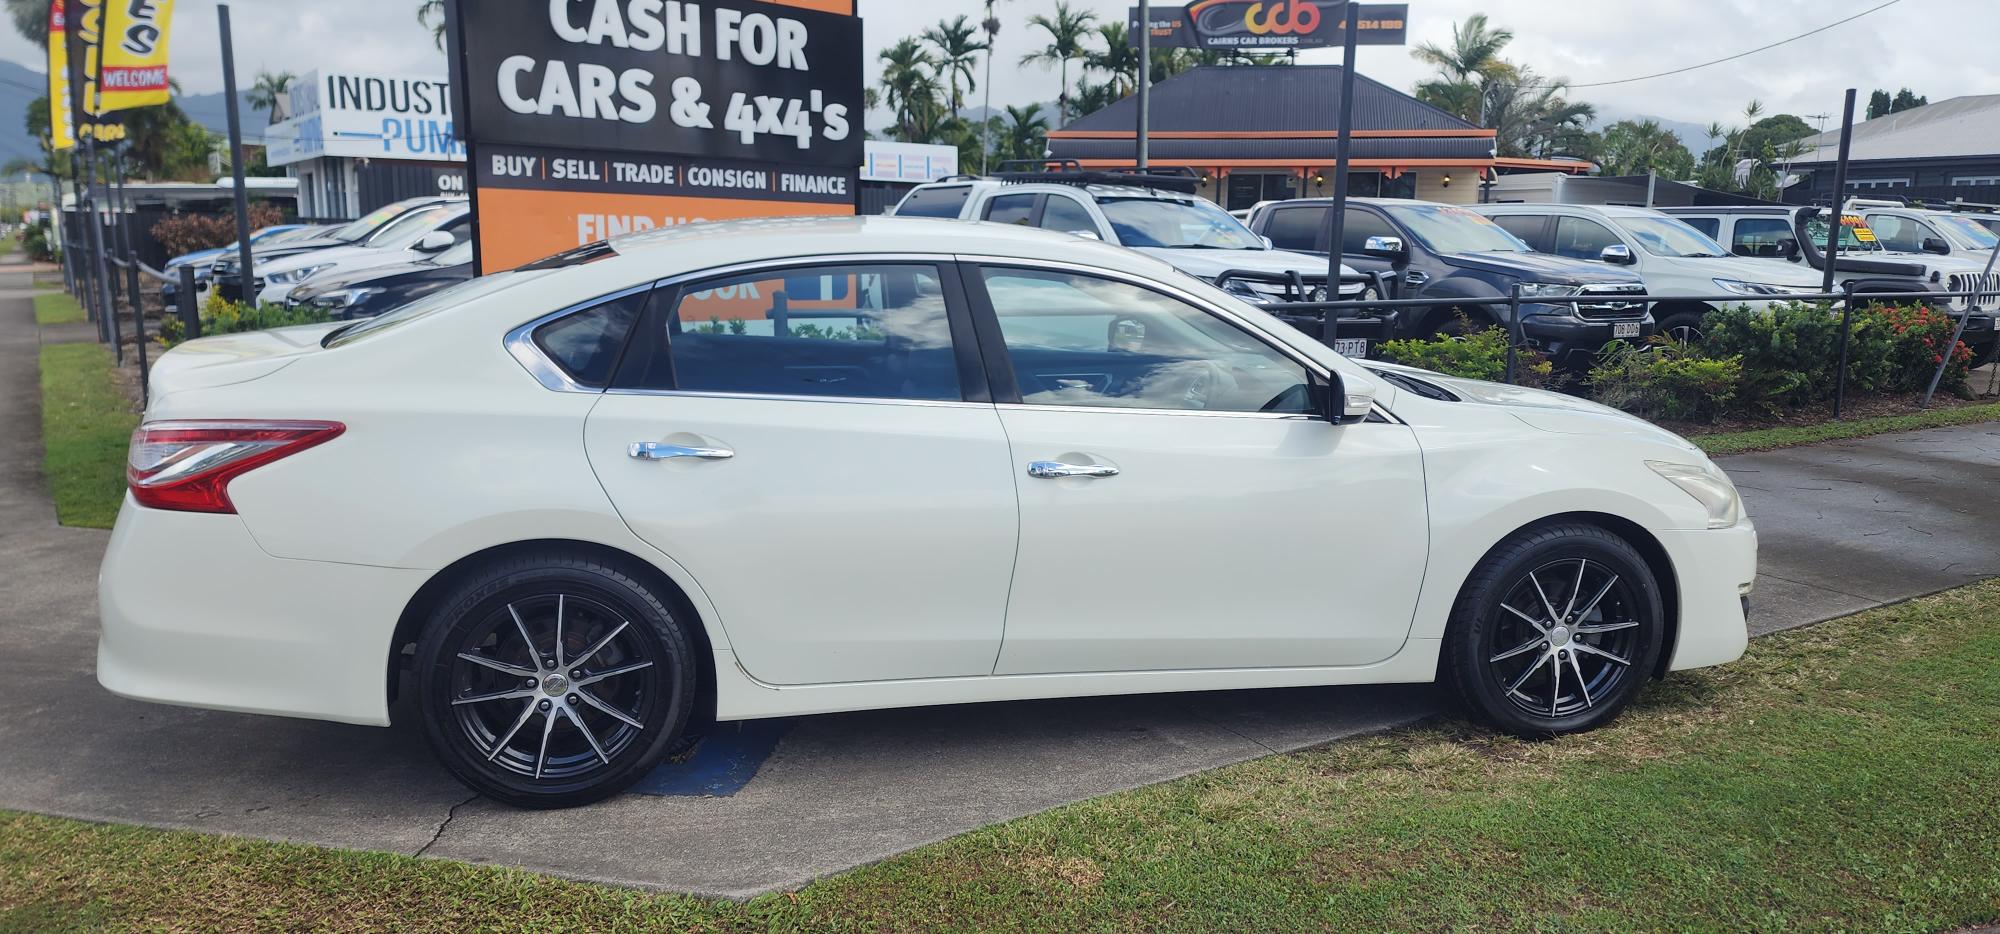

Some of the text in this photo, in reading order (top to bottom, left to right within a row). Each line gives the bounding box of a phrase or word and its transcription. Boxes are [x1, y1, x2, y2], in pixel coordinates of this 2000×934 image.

[549, 0, 809, 71] CASH FOR
[1208, 37, 1239, 45] CAIRNS
[1240, 37, 1257, 45] CAR
[1258, 37, 1299, 45] BROKERS
[103, 68, 166, 87] WELCOME
[327, 75, 450, 115] INDUST
[498, 55, 657, 124] CARS
[670, 77, 714, 129] &
[437, 174, 464, 191] ON
[491, 155, 847, 195] BUY SELL TRADE CONSIGN FINANCE
